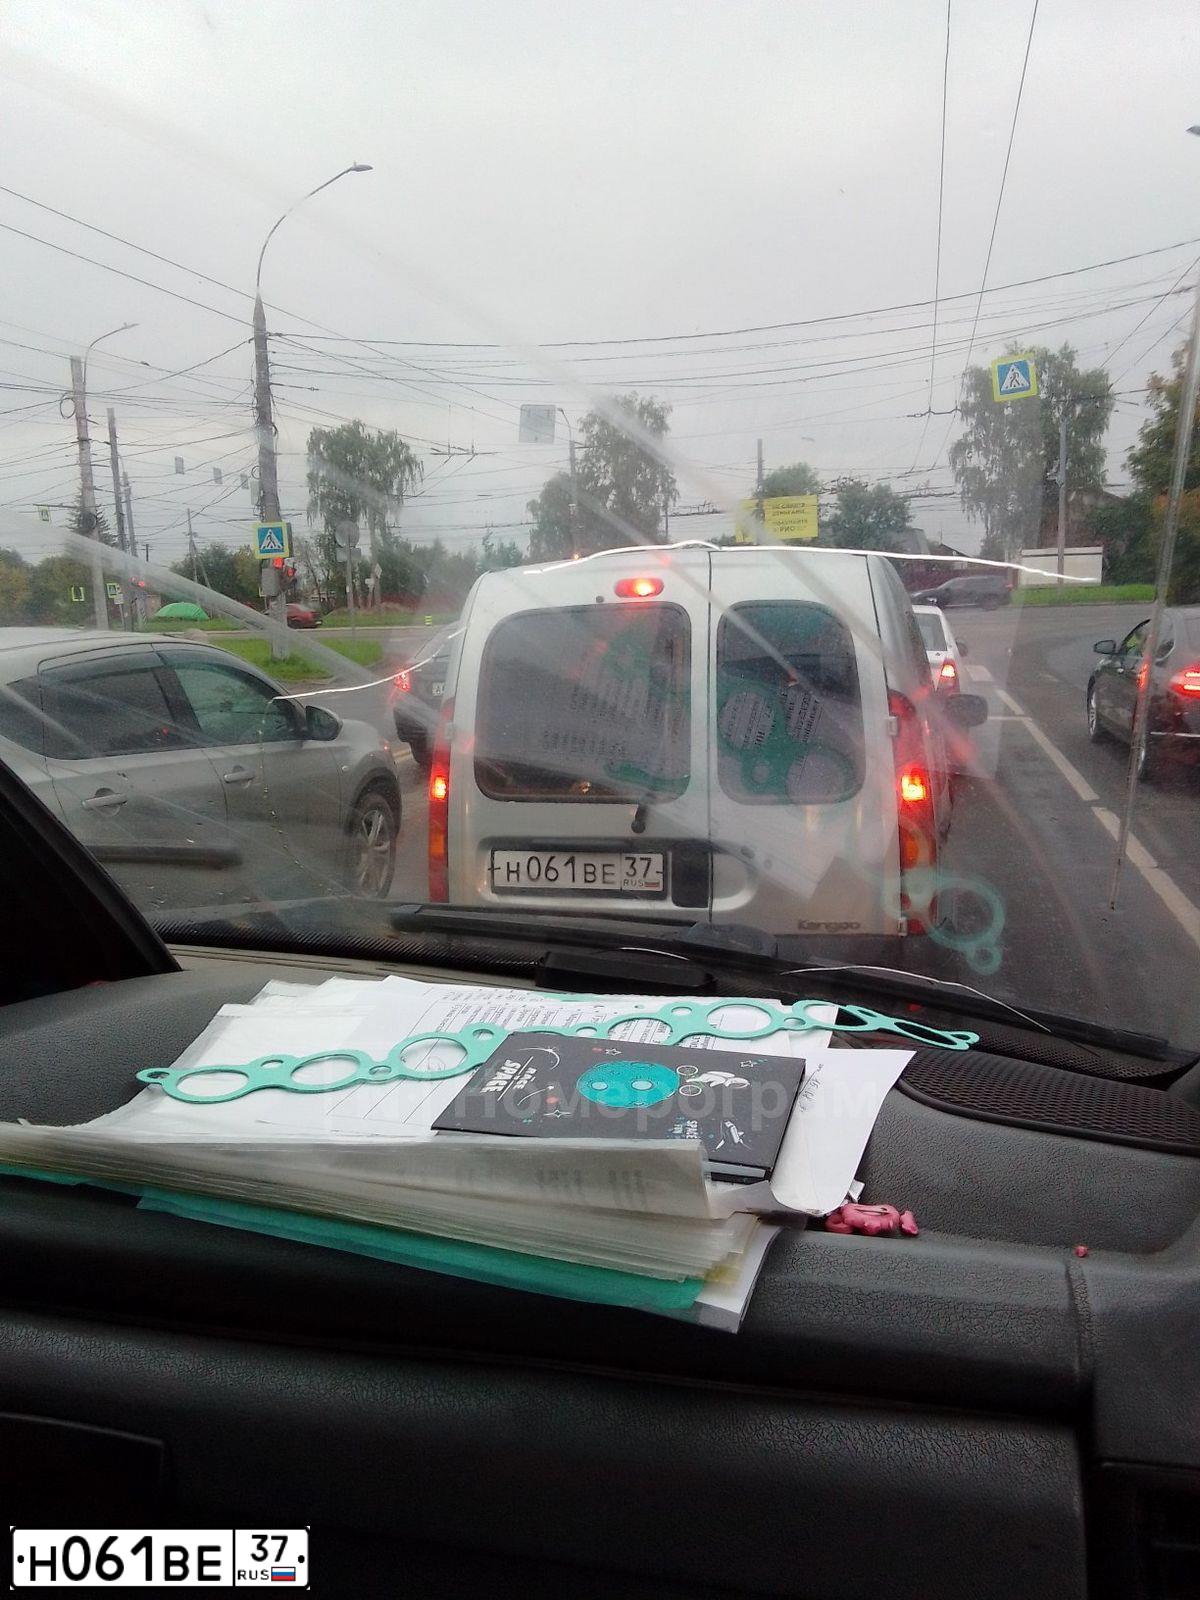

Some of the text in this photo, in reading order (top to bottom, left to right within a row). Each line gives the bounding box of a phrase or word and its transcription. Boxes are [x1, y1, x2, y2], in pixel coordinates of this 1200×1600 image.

[624, 856, 652, 879] 37
[623, 879, 644, 888] RUS
[480, 1059, 522, 1093] SPACE
[512, 1066, 538, 1091] RACE
[685, 1120, 699, 1139] SPACE
